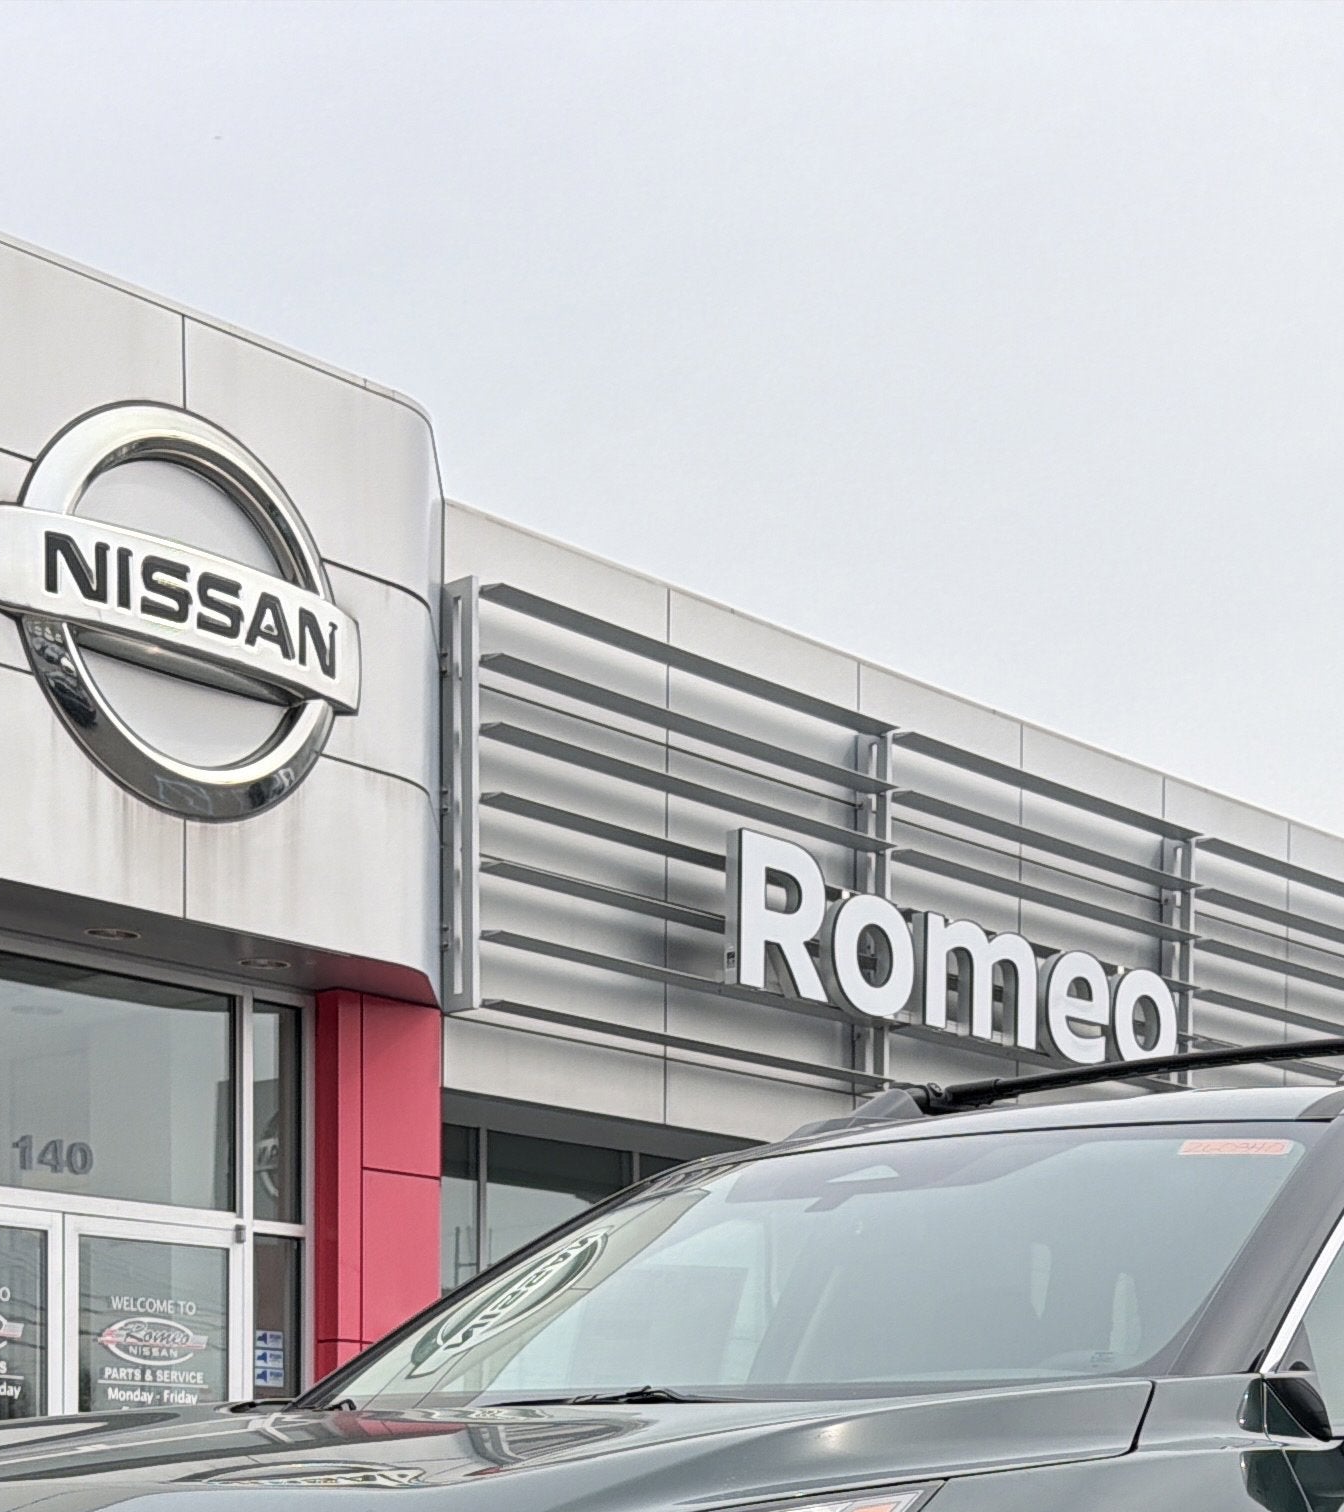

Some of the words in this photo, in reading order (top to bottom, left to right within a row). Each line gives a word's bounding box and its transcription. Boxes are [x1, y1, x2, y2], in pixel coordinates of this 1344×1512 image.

[44, 530, 339, 680] NISSAN
[728, 827, 1178, 1064] Romeo
[12, 1134, 94, 1175] 140
[111, 1296, 174, 1314] WELCOME
[176, 1301, 196, 1315] TO
[119, 1320, 191, 1345] Romeo
[129, 1346, 178, 1357] NISSAN
[104, 1367, 142, 1380] PARTS
[144, 1368, 153, 1381] &
[156, 1369, 204, 1383] SERVICE
[108, 1387, 154, 1404] Monday
[163, 1390, 198, 1405] Friday
